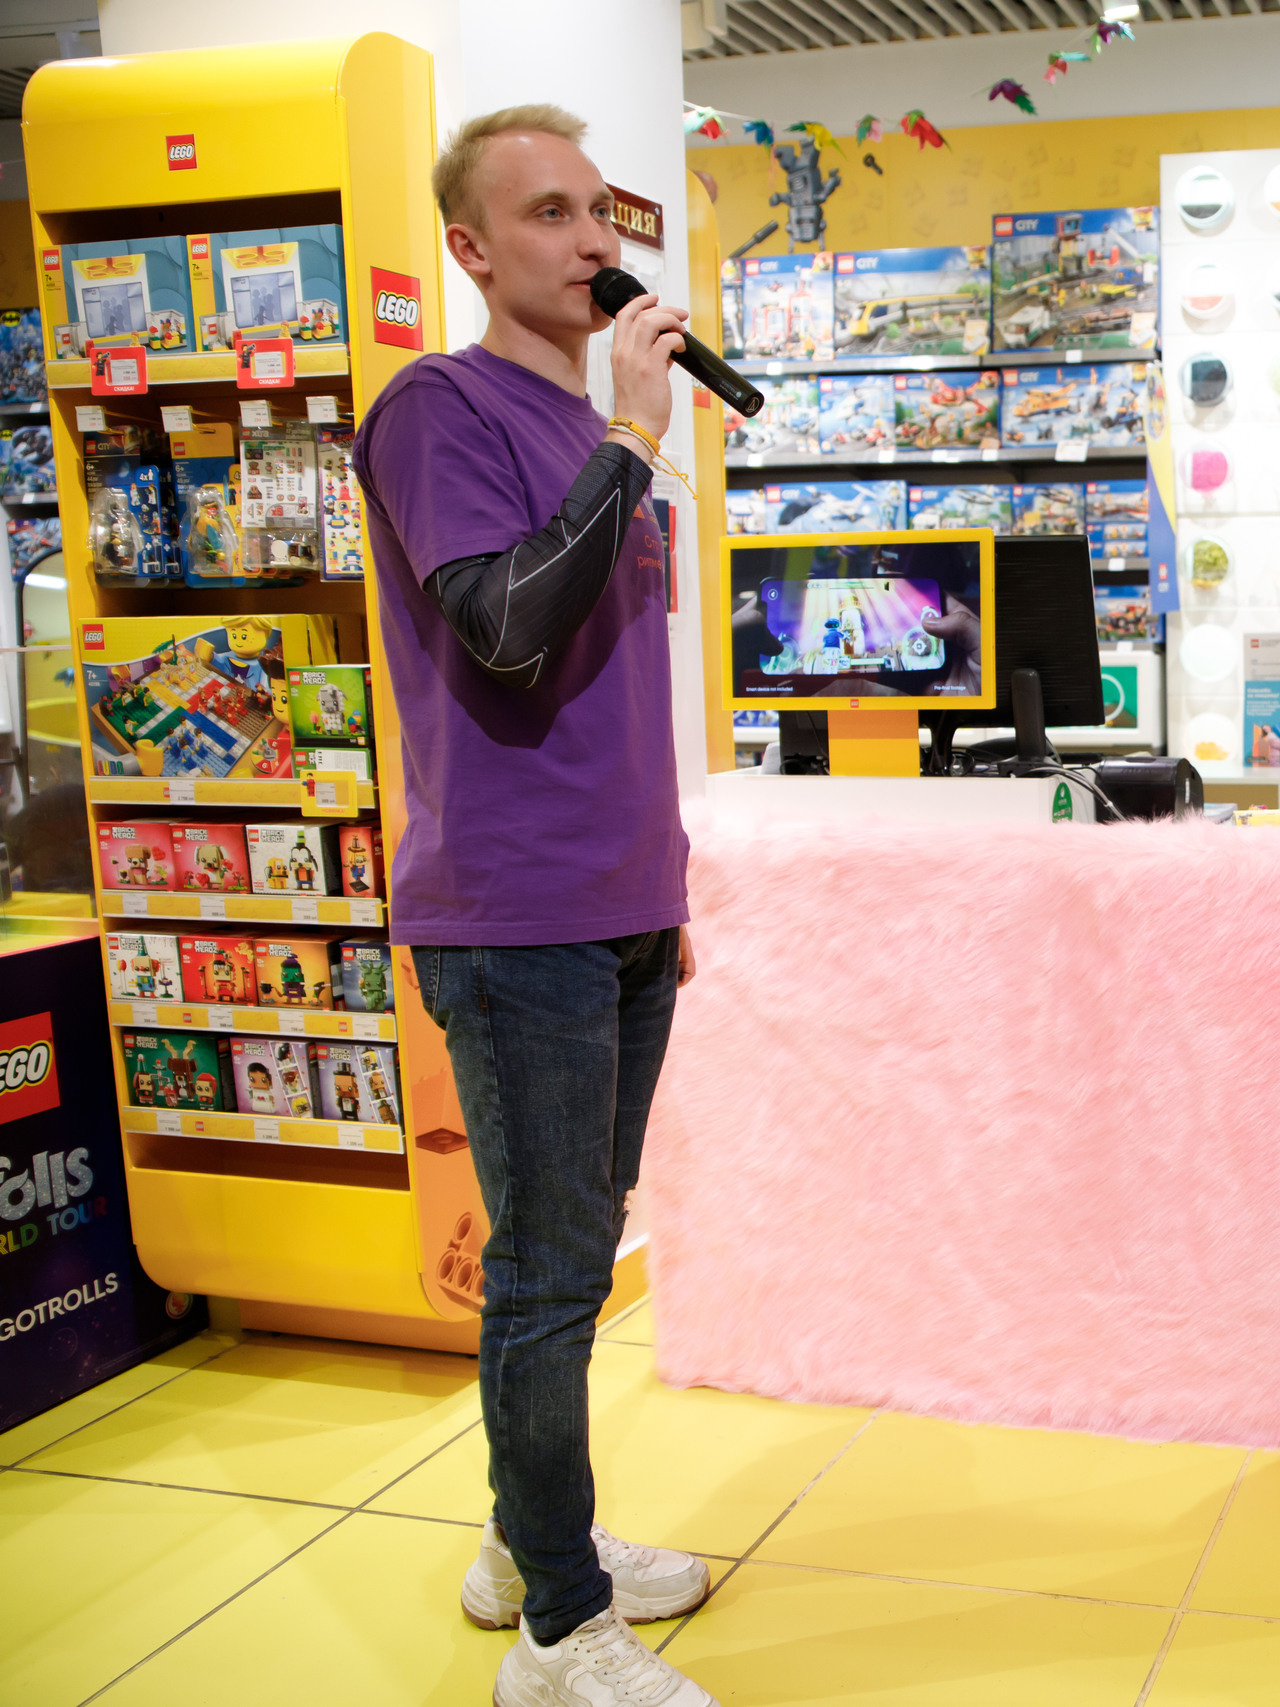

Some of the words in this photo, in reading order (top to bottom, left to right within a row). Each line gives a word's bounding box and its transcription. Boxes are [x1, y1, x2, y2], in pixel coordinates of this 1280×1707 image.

[170, 145, 193, 159] LEGO
[610, 200, 657, 238] ЦИЯ
[1015, 219, 1039, 231] CITY
[856, 258, 878, 269] CITY
[377, 293, 418, 326] LEGO
[85, 632, 102, 642] LEGO
[87, 670, 97, 679] 7+
[98, 760, 124, 775] LUDO
[47, 1196, 107, 1236] TOUR
